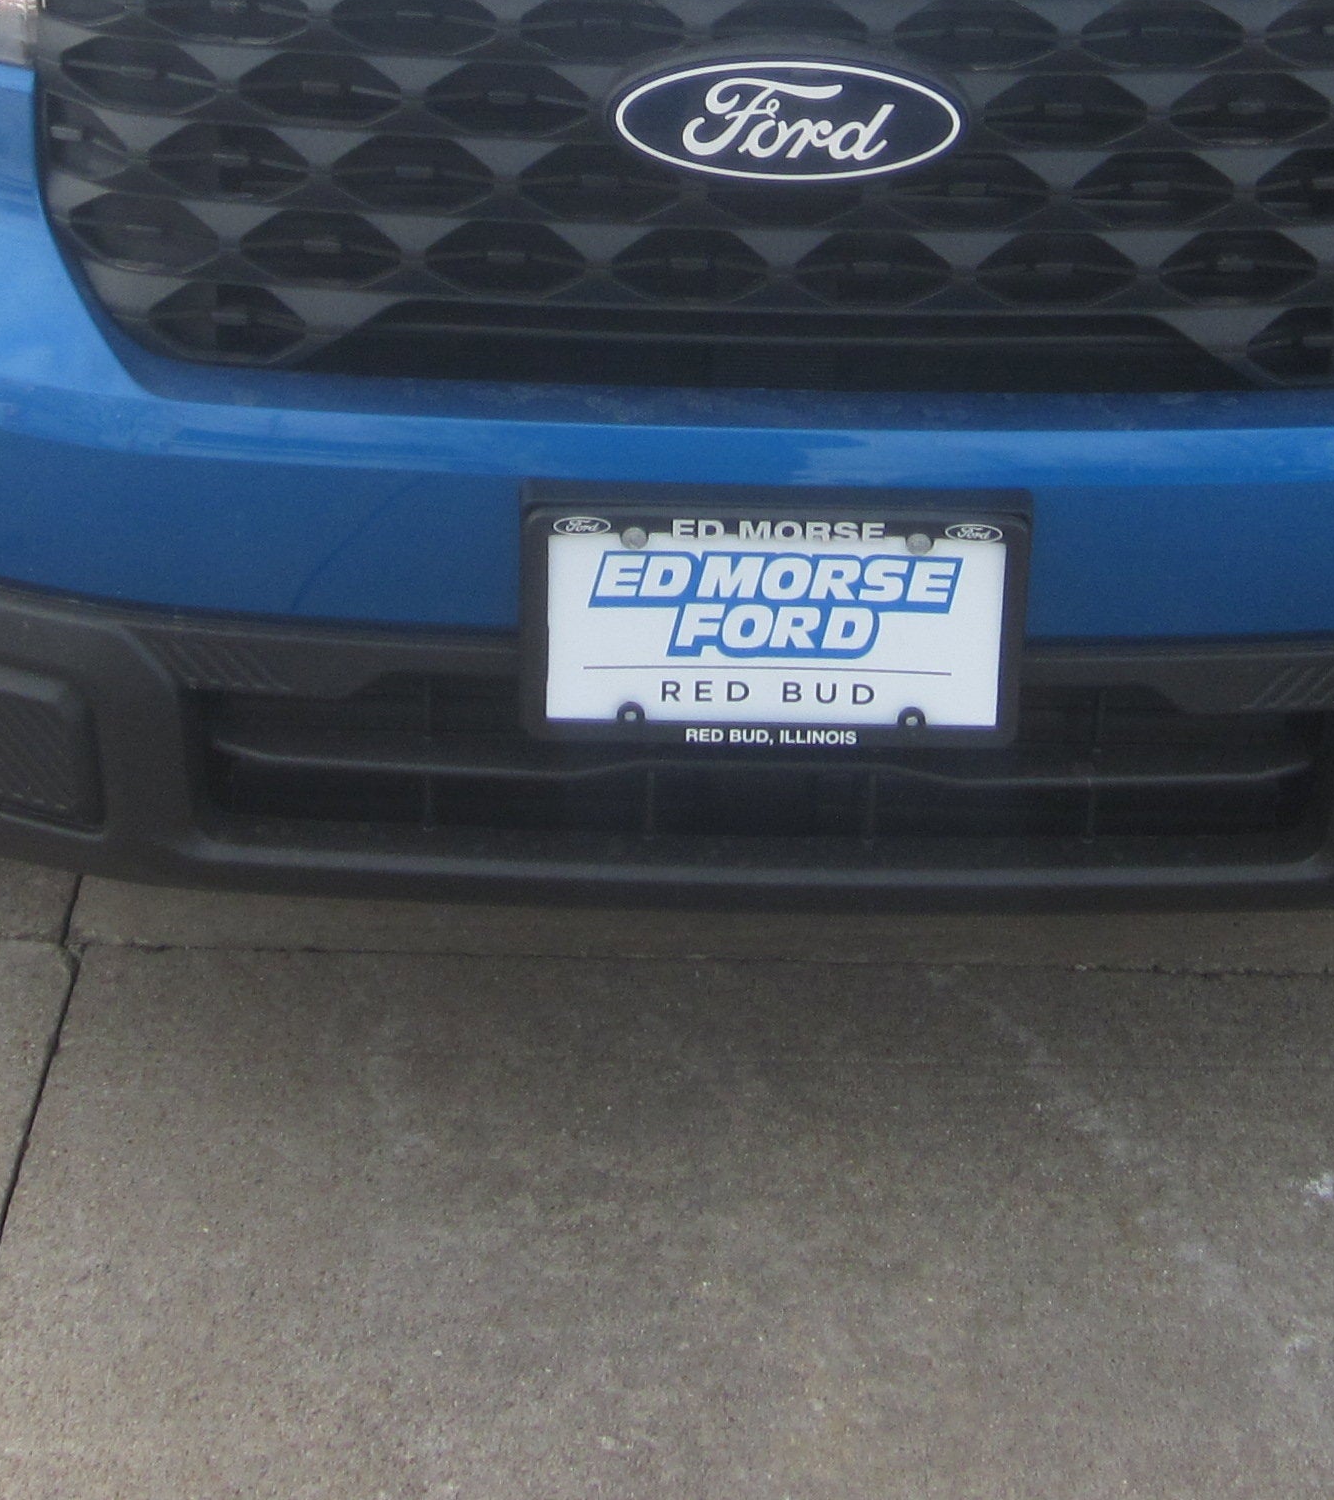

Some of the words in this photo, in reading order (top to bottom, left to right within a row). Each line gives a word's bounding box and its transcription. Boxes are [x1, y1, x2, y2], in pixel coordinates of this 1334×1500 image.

[681, 76, 896, 162] Ford
[565, 518, 599, 533] Ford
[671, 518, 725, 540] ED
[738, 519, 886, 543] MORSE
[955, 525, 992, 541] Ford
[593, 553, 694, 598] ED
[695, 554, 958, 604] MORSE
[674, 602, 875, 651] FORD
[660, 680, 751, 703] RED
[781, 681, 876, 706] BUD
[684, 728, 724, 743] RED
[729, 729, 775, 746] BUD,
[779, 730, 858, 745] ILLINOIS
